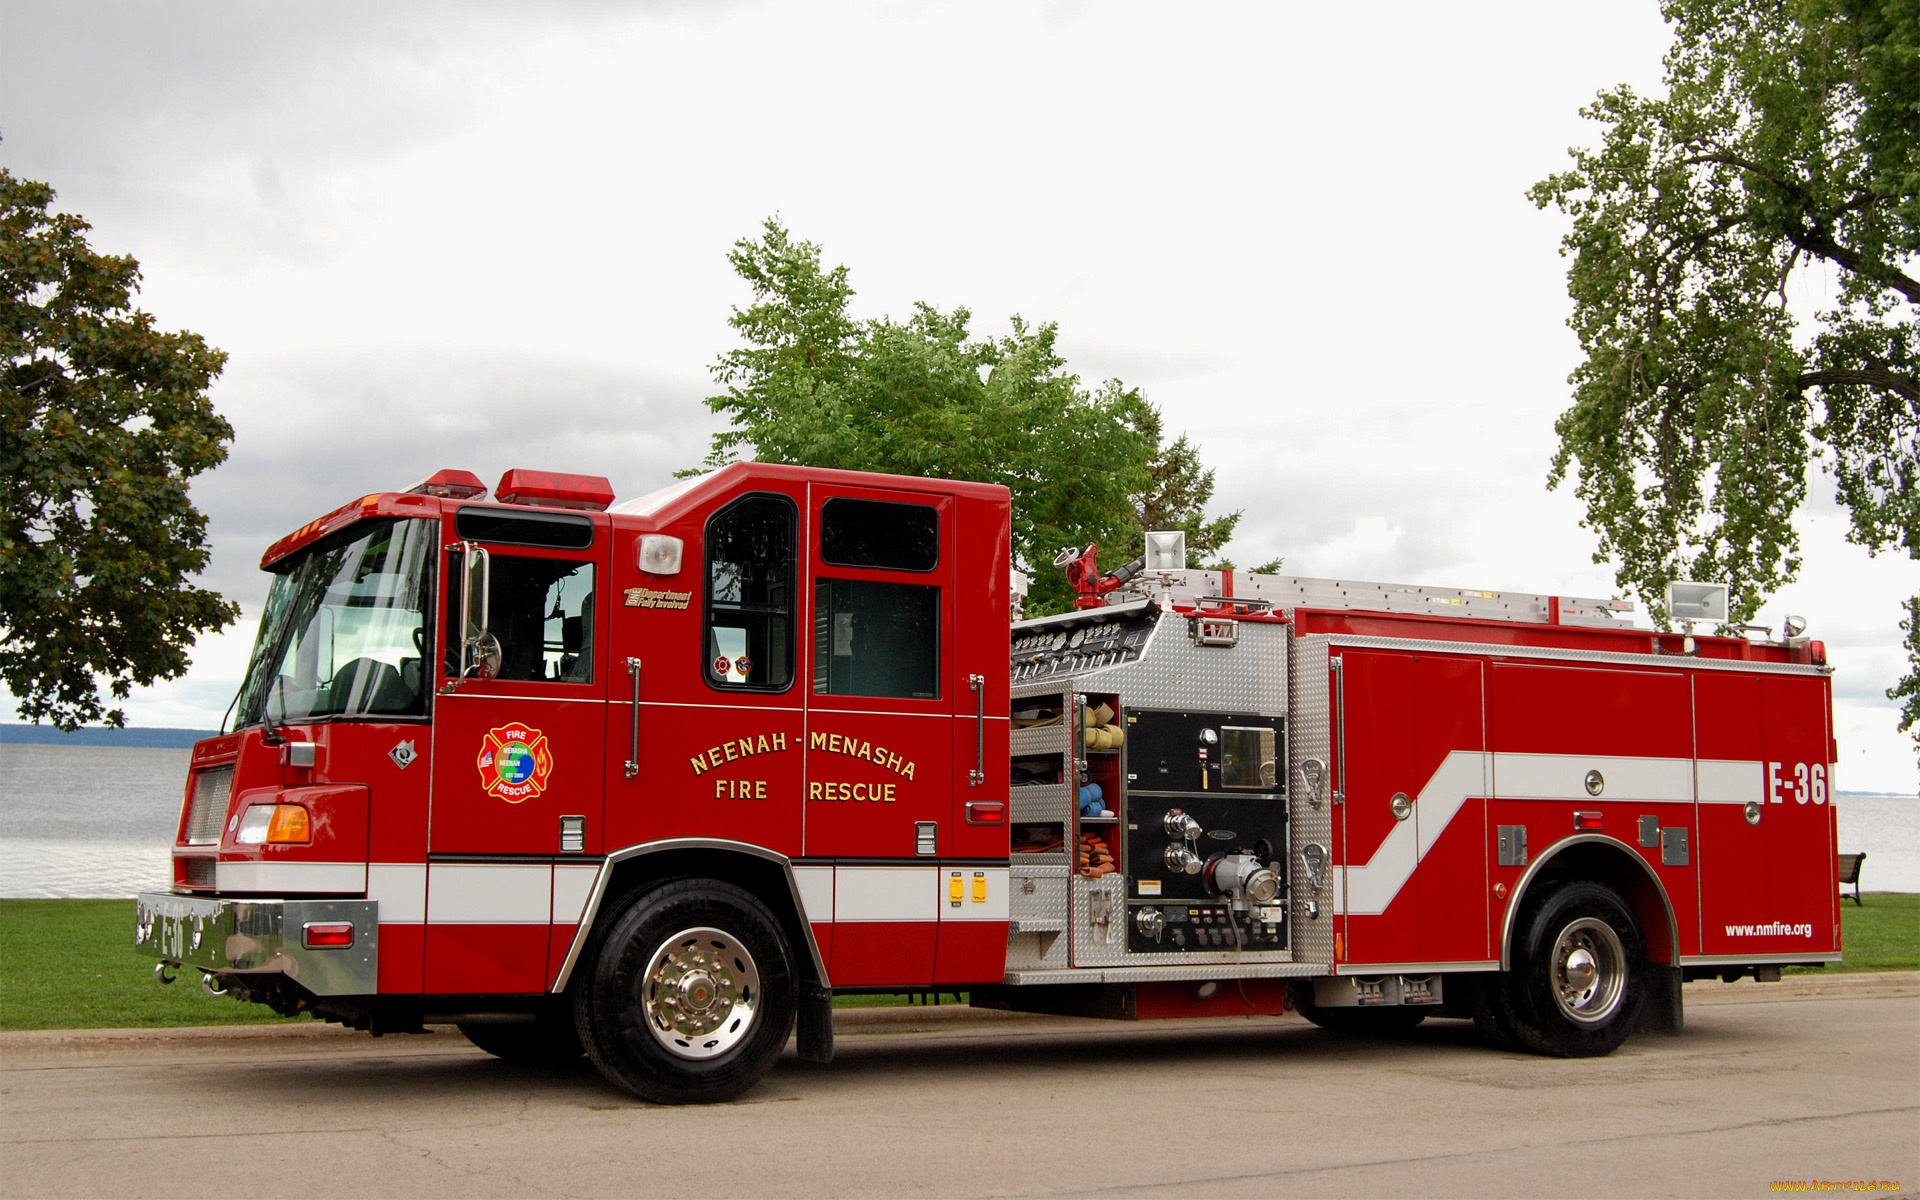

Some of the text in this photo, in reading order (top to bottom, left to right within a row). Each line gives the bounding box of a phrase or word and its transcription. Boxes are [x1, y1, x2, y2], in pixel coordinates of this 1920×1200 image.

[641, 588, 693, 600] Department
[506, 730, 527, 740] FIRE
[689, 731, 788, 777] NEENAH
[810, 731, 916, 782] MENASHA
[497, 783, 532, 796] RESCUE
[714, 779, 897, 803] FIRE RESCUE
[1768, 761, 1826, 806] E-36
[1725, 921, 1812, 938] www.nmfire.org
